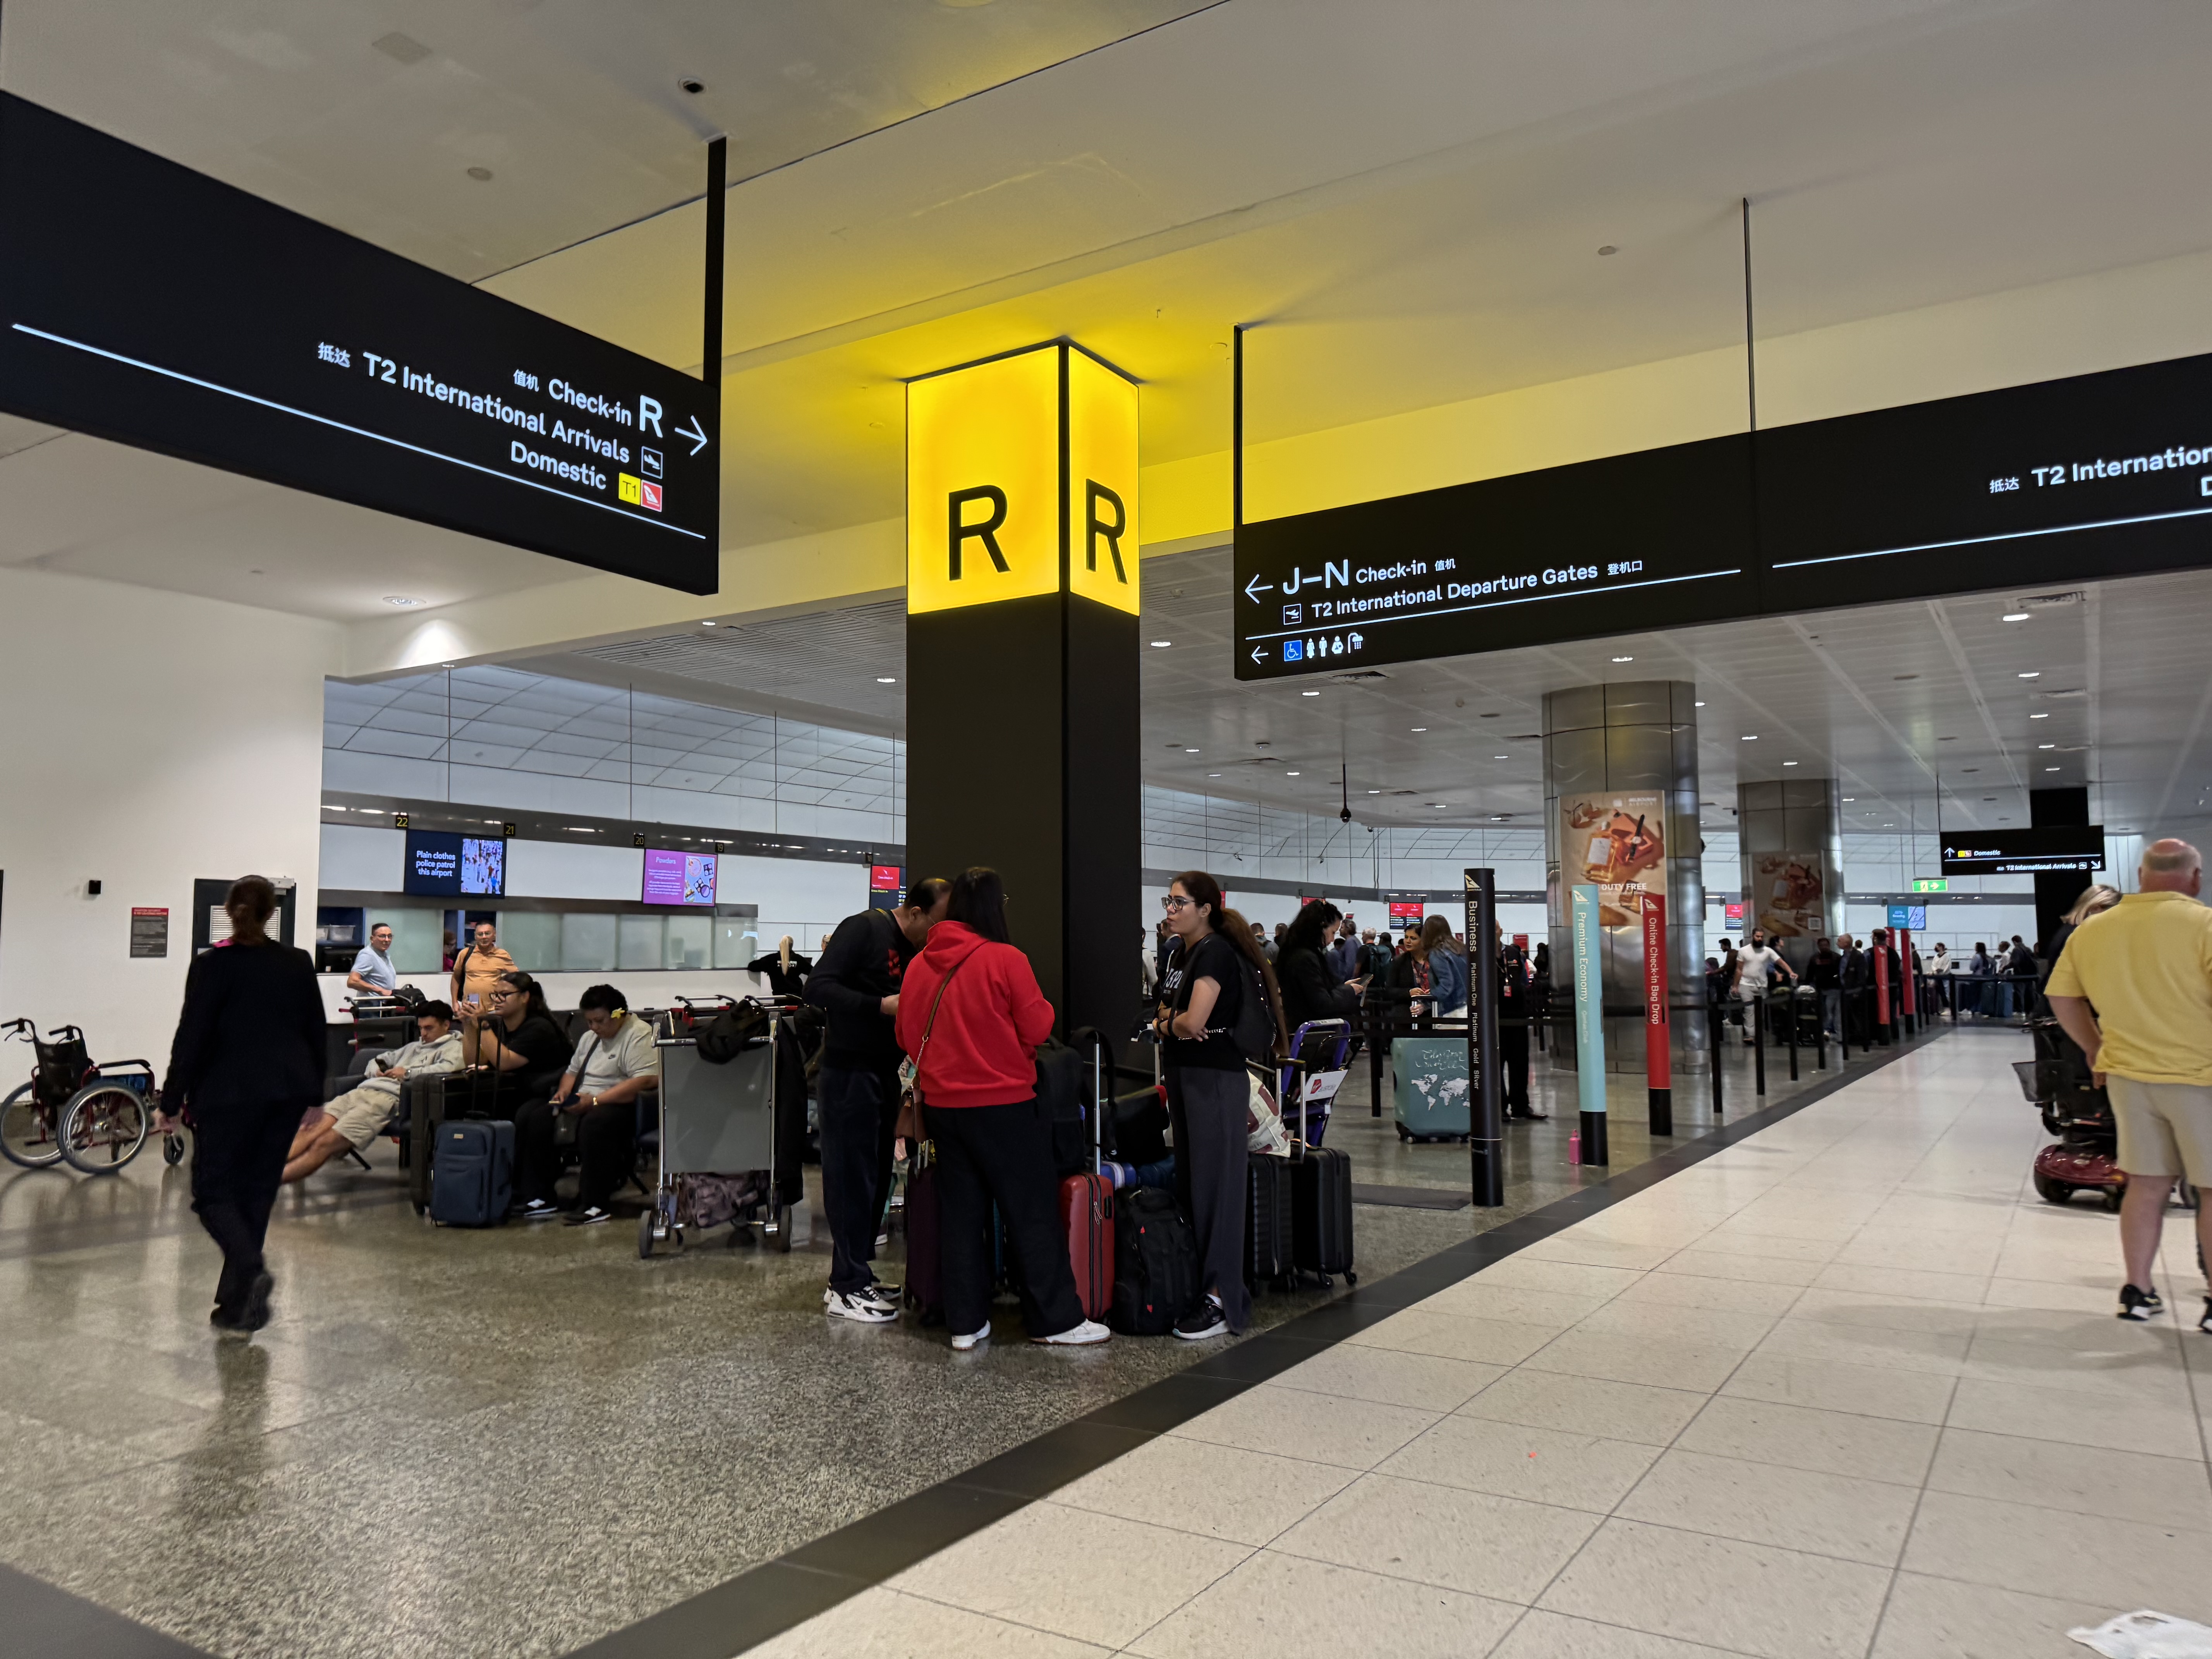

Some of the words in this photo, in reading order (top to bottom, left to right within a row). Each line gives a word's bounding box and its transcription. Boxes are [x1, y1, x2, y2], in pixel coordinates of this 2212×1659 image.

[318, 342, 350, 368] 抵达
[363, 352, 396, 384] T2
[403, 366, 546, 435] International
[551, 420, 630, 463] Arrivals
[513, 369, 539, 392] 值机
[548, 378, 631, 426] Check-in
[639, 395, 663, 438] R
[511, 440, 606, 489] Domestic
[622, 481, 636, 497] T1
[1989, 477, 2020, 493] 抵达
[2031, 465, 2065, 487] T2
[948, 484, 1012, 581] R
[1086, 478, 1128, 585] R
[1356, 560, 1426, 584] Check-in
[1434, 558, 1456, 571] 值机
[1311, 602, 1333, 618] T2
[1337, 585, 1443, 615] International
[1448, 575, 1537, 599] Departure
[1542, 565, 1598, 584] Gates
[1607, 560, 1642, 575] 登机口
[397, 817, 408, 827] 22
[506, 825, 514, 835] 21
[416, 850, 432, 859] Plain
[433, 852, 455, 860] clothes
[416, 860, 435, 868] police
[436, 861, 455, 869] patrol
[431, 869, 452, 878] airport
[1469, 901, 1479, 952] Business
[1578, 912, 1588, 955] Premium
[1649, 917, 1657, 945] Online
[1580, 958, 1588, 1002] Economy
[1650, 946, 1659, 983] Check-in
[1650, 986, 1659, 1002] Bag
[1651, 1004, 1660, 1024] Drop
